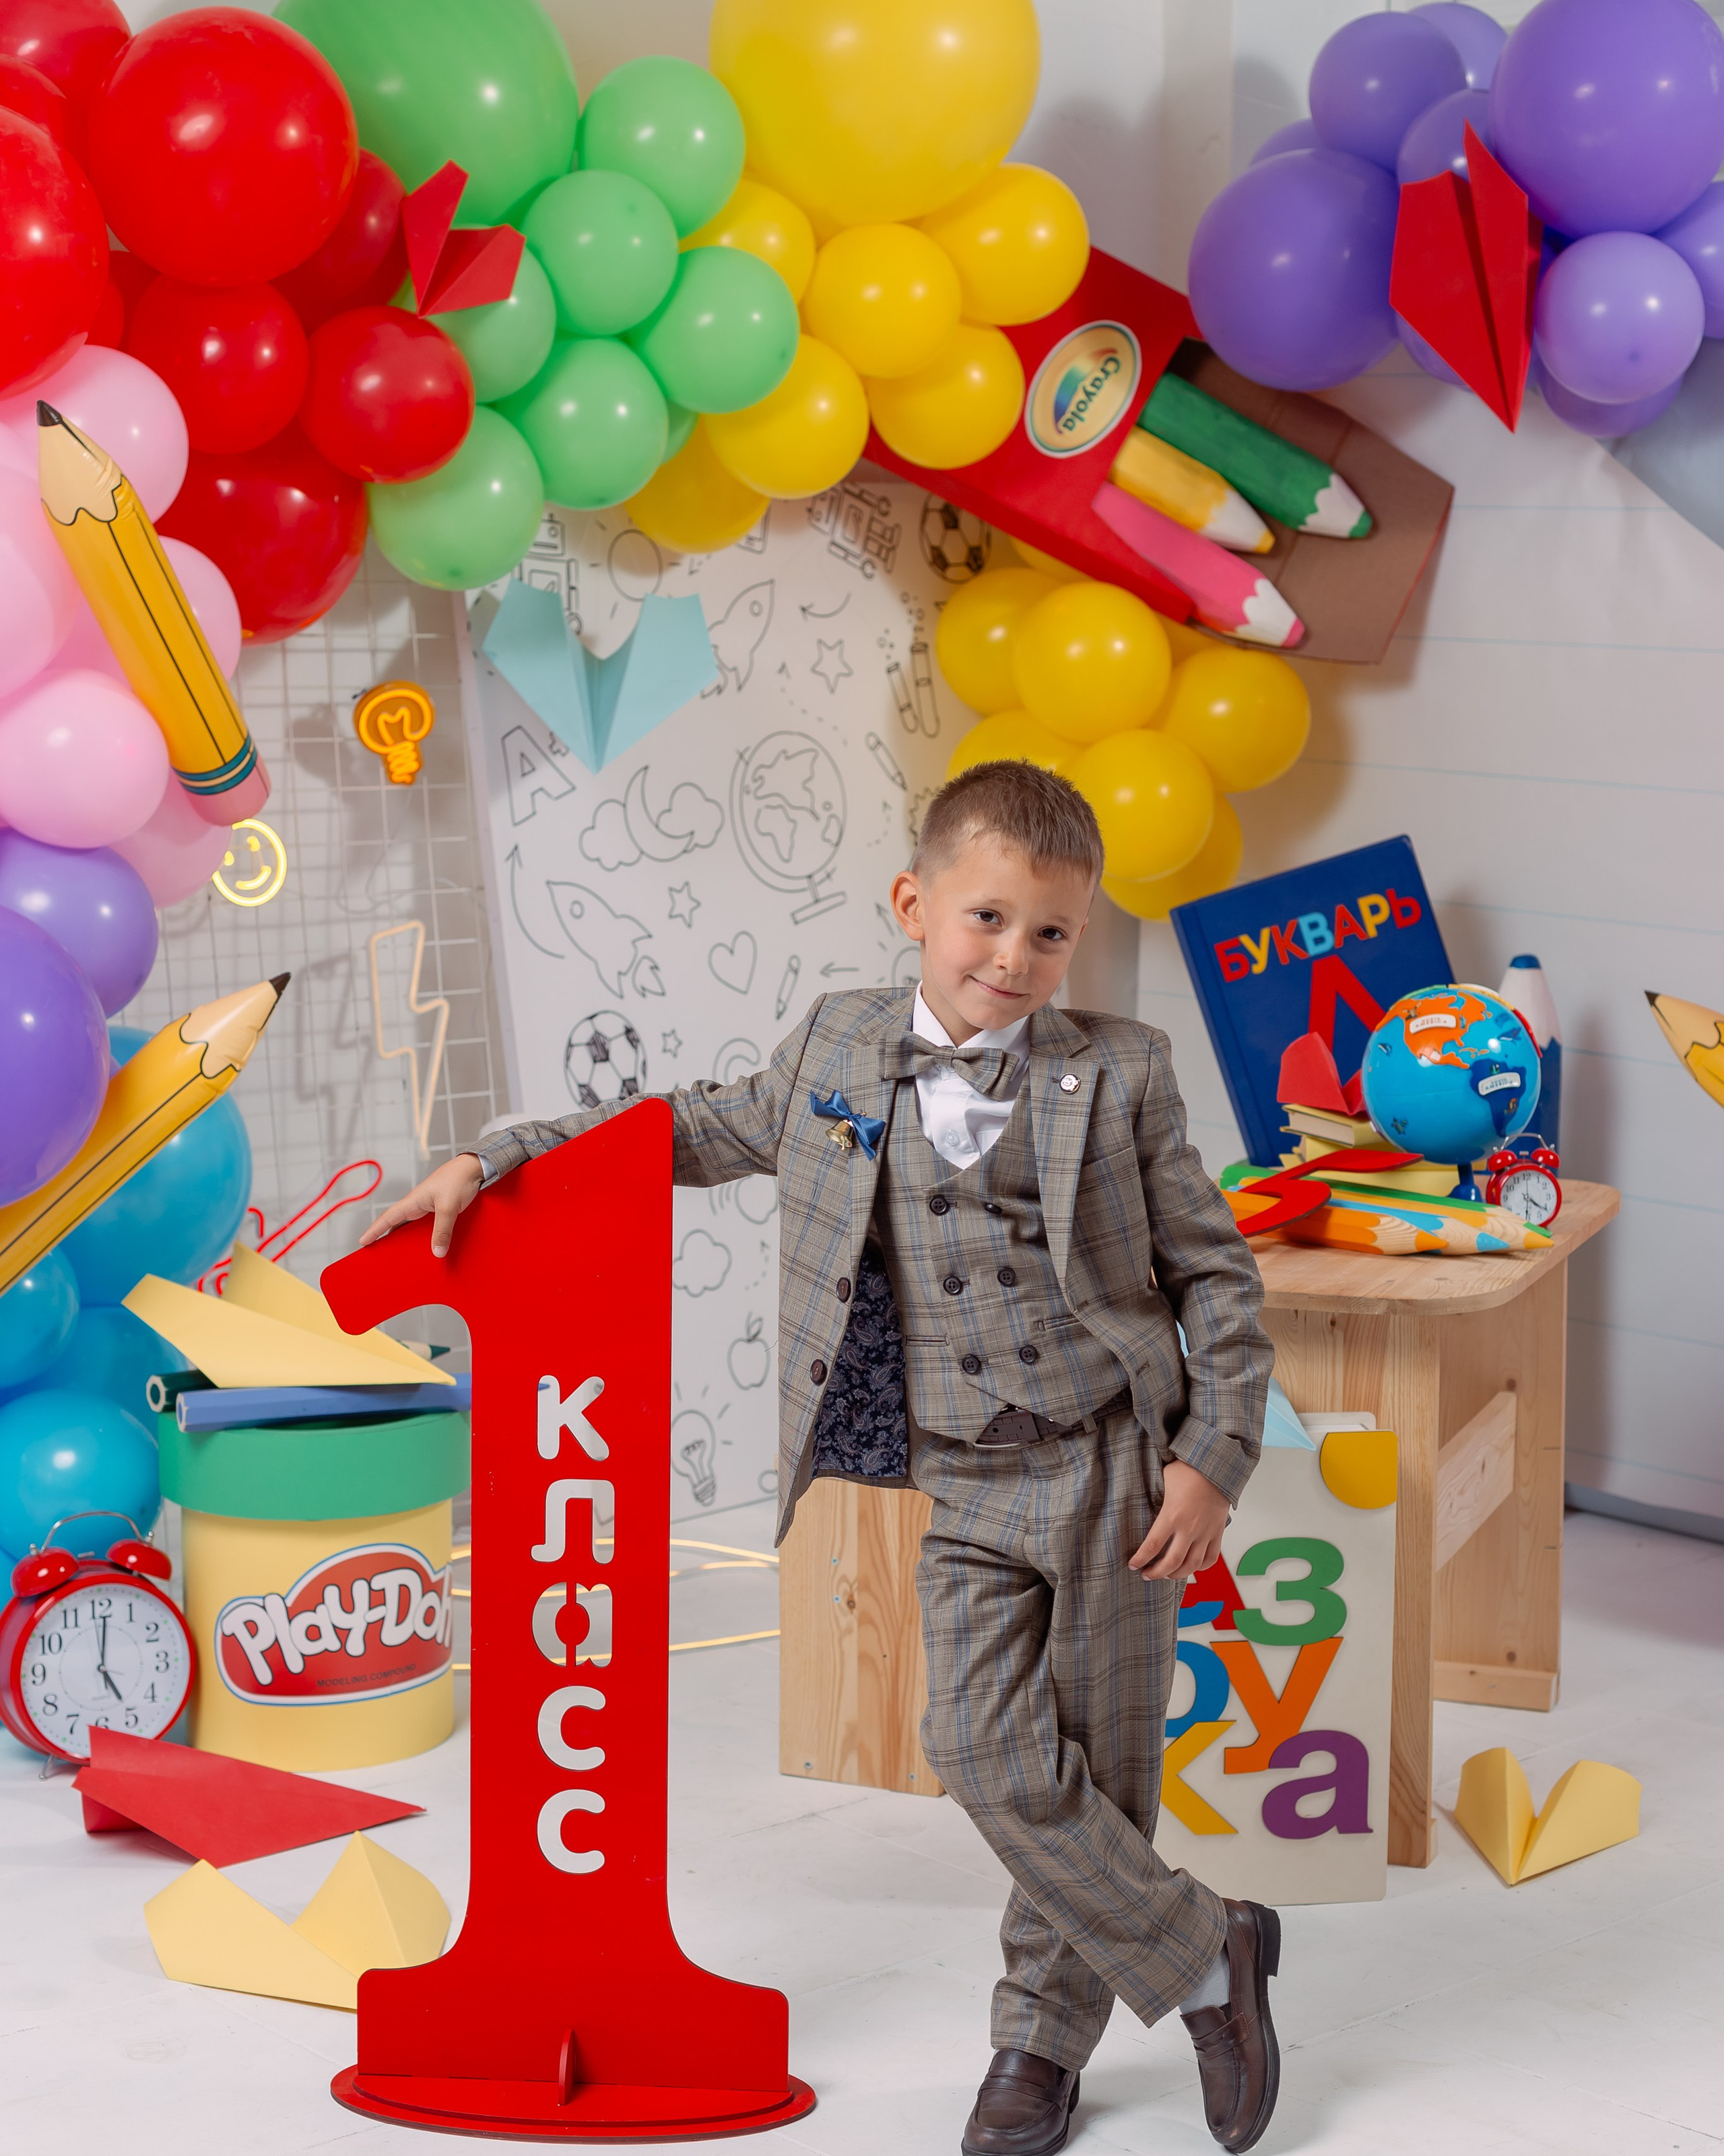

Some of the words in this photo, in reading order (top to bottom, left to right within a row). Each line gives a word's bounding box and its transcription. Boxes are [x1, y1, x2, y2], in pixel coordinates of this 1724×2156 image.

[1062, 356, 1121, 431] Crayola
[1214, 888, 1422, 983] БУКВАРЬ
[62, 1608, 81, 1629] 11
[90, 1598, 112, 1619] 12
[127, 1602, 136, 1623] 1
[145, 1621, 159, 1643] 2
[220, 1564, 452, 1685] Play-Doh
[38, 1632, 63, 1656] 10
[155, 1650, 169, 1674] 3
[31, 1662, 46, 1686] 9
[317, 1675, 367, 1687] MODELING
[370, 1663, 416, 1680] COMPOUND
[143, 1683, 158, 1703] 4
[42, 1694, 59, 1716] 8
[65, 1713, 79, 1734] 7
[125, 1706, 139, 1729] 5
